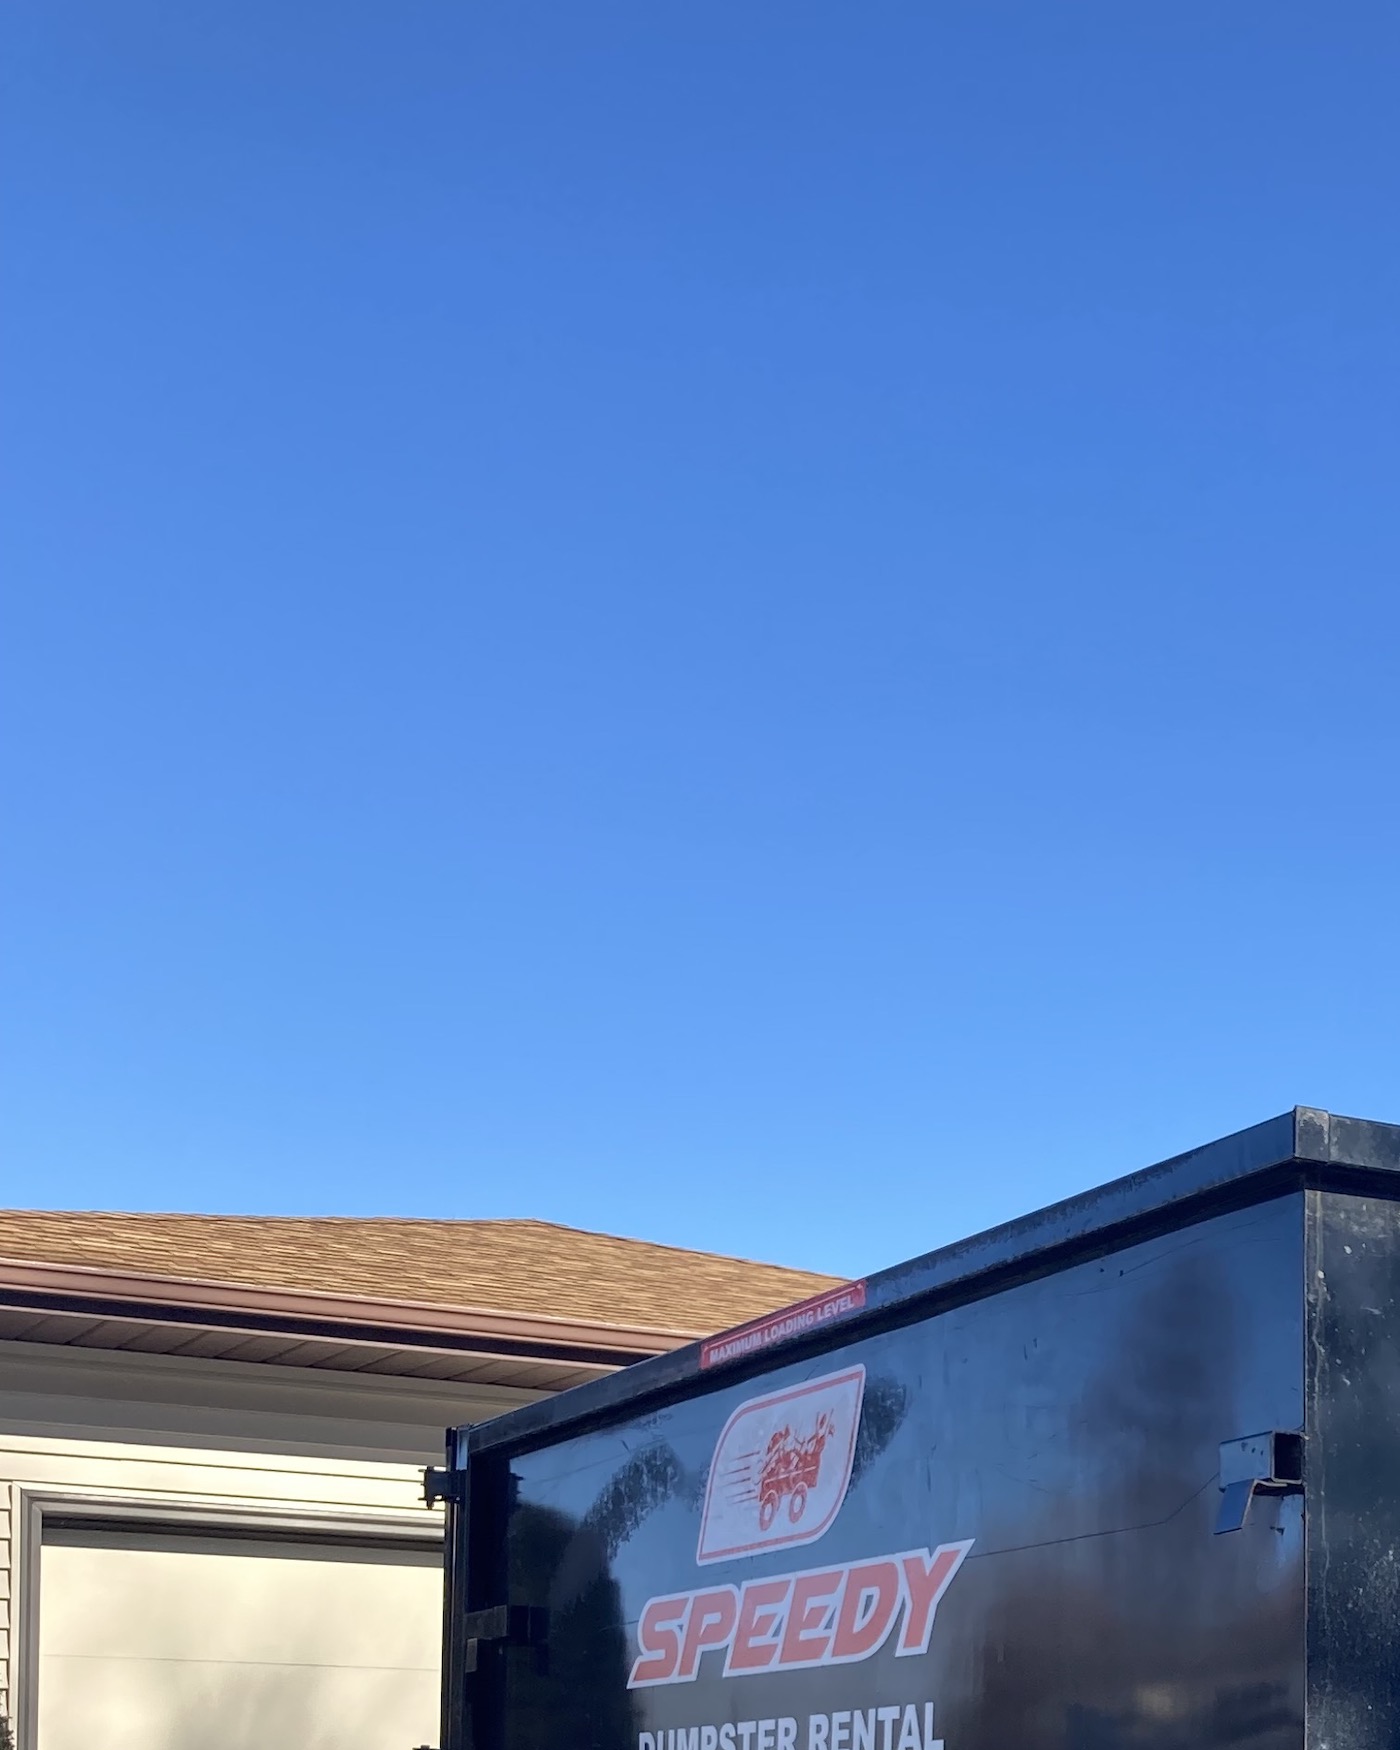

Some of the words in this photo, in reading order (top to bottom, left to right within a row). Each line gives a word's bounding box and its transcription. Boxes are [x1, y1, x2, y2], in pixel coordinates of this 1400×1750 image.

[710, 1333, 763, 1363] MAXIMUM
[764, 1312, 815, 1342] LOADING
[816, 1295, 854, 1320] LEVEL
[626, 1538, 976, 1689] SPEEDY
